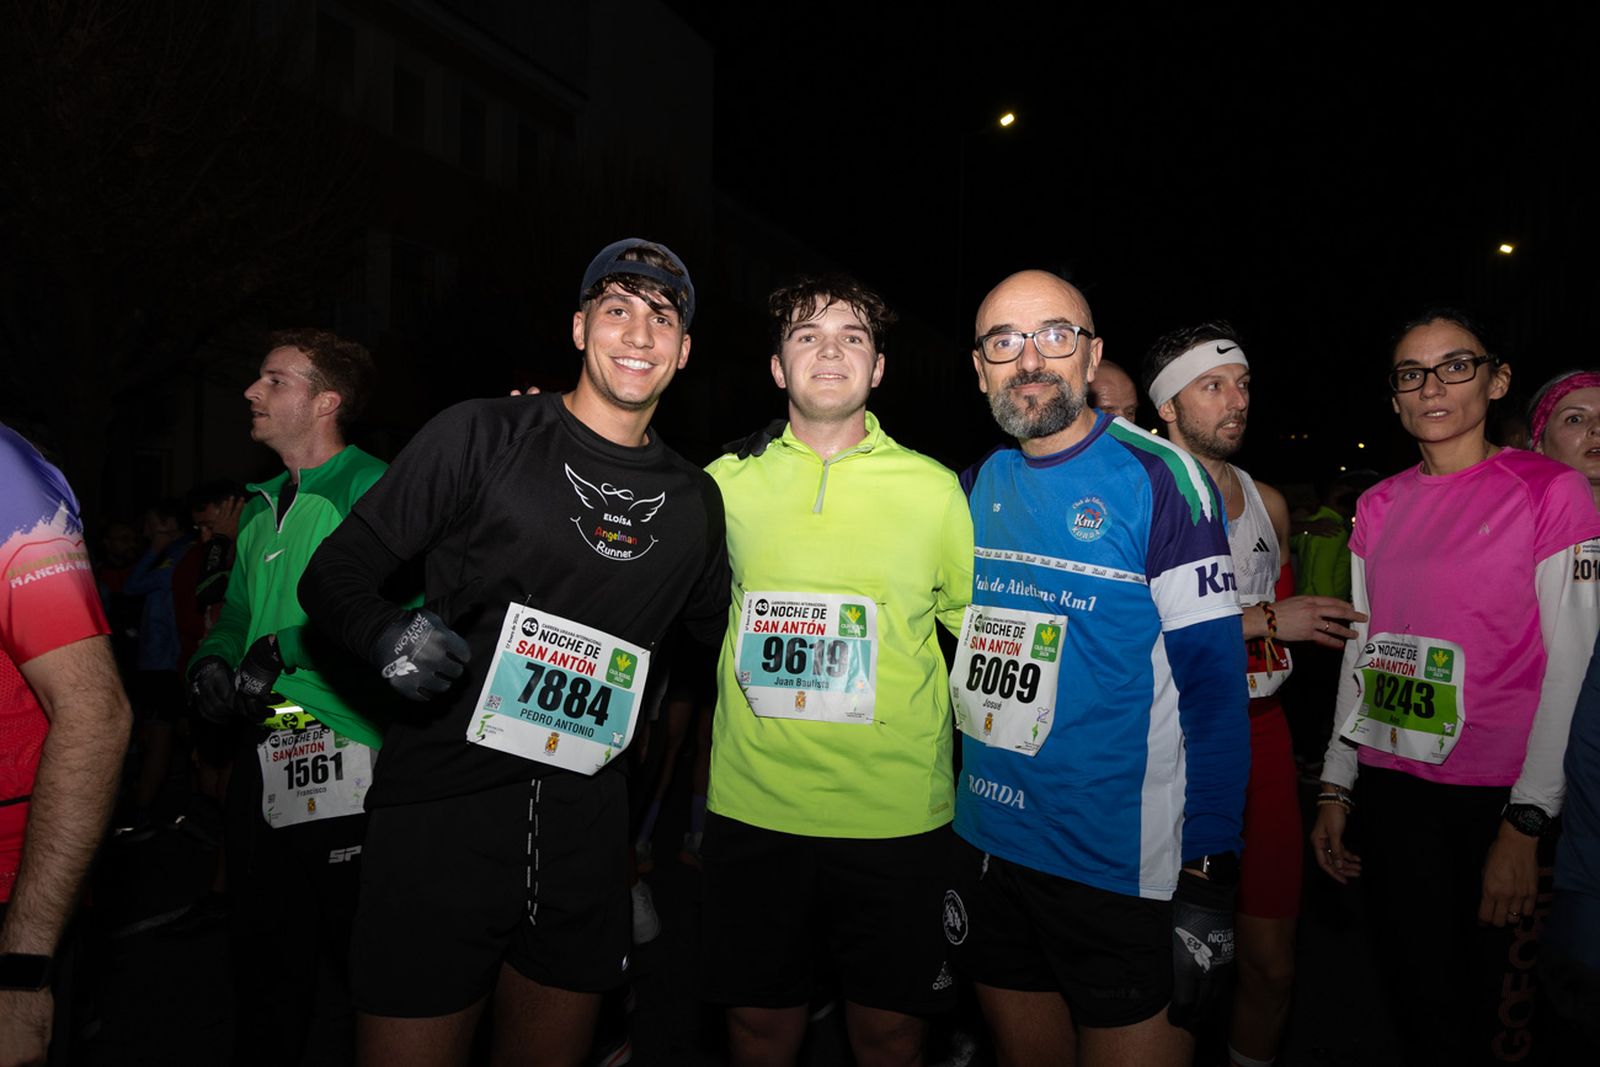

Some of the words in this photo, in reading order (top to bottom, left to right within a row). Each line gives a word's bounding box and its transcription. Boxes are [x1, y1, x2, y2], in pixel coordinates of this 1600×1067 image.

[603, 512, 632, 526] ELOÍSA
[1074, 513, 1104, 529] Km1
[595, 526, 638, 544] Angelman
[596, 540, 632, 558] Runner
[1574, 560, 1600, 580] 201
[976, 574, 989, 591] lub
[990, 577, 1005, 592] de
[1060, 590, 1096, 612] Km1
[770, 606, 809, 618] NOCHE
[811, 608, 827, 619] DE
[753, 620, 779, 633] SAN
[780, 619, 826, 635] ANTÓN
[980, 621, 1012, 637] NOCHE
[1013, 626, 1026, 639] DE
[522, 620, 537, 632] 43
[538, 630, 584, 653] NOCHE
[584, 644, 601, 659] DE
[988, 638, 1022, 656] ANTÓN
[516, 640, 548, 661] SAN
[548, 650, 596, 677] ANTÓN
[761, 636, 848, 677] 9619
[1378, 645, 1406, 658] NOCHE
[1407, 649, 1417, 660] DE
[1384, 660, 1416, 676] ANTÓN
[774, 677, 793, 686] Juan
[796, 677, 829, 688] Bautista
[966, 653, 1041, 704] 6069
[517, 662, 613, 727] 7884
[1373, 673, 1435, 719] 8243
[520, 708, 553, 726] PEDRO
[554, 718, 594, 738] ANTONIO
[313, 731, 324, 740] DE
[272, 749, 292, 762] SAN
[284, 752, 343, 790] 1561
[296, 786, 327, 797] Francisco
